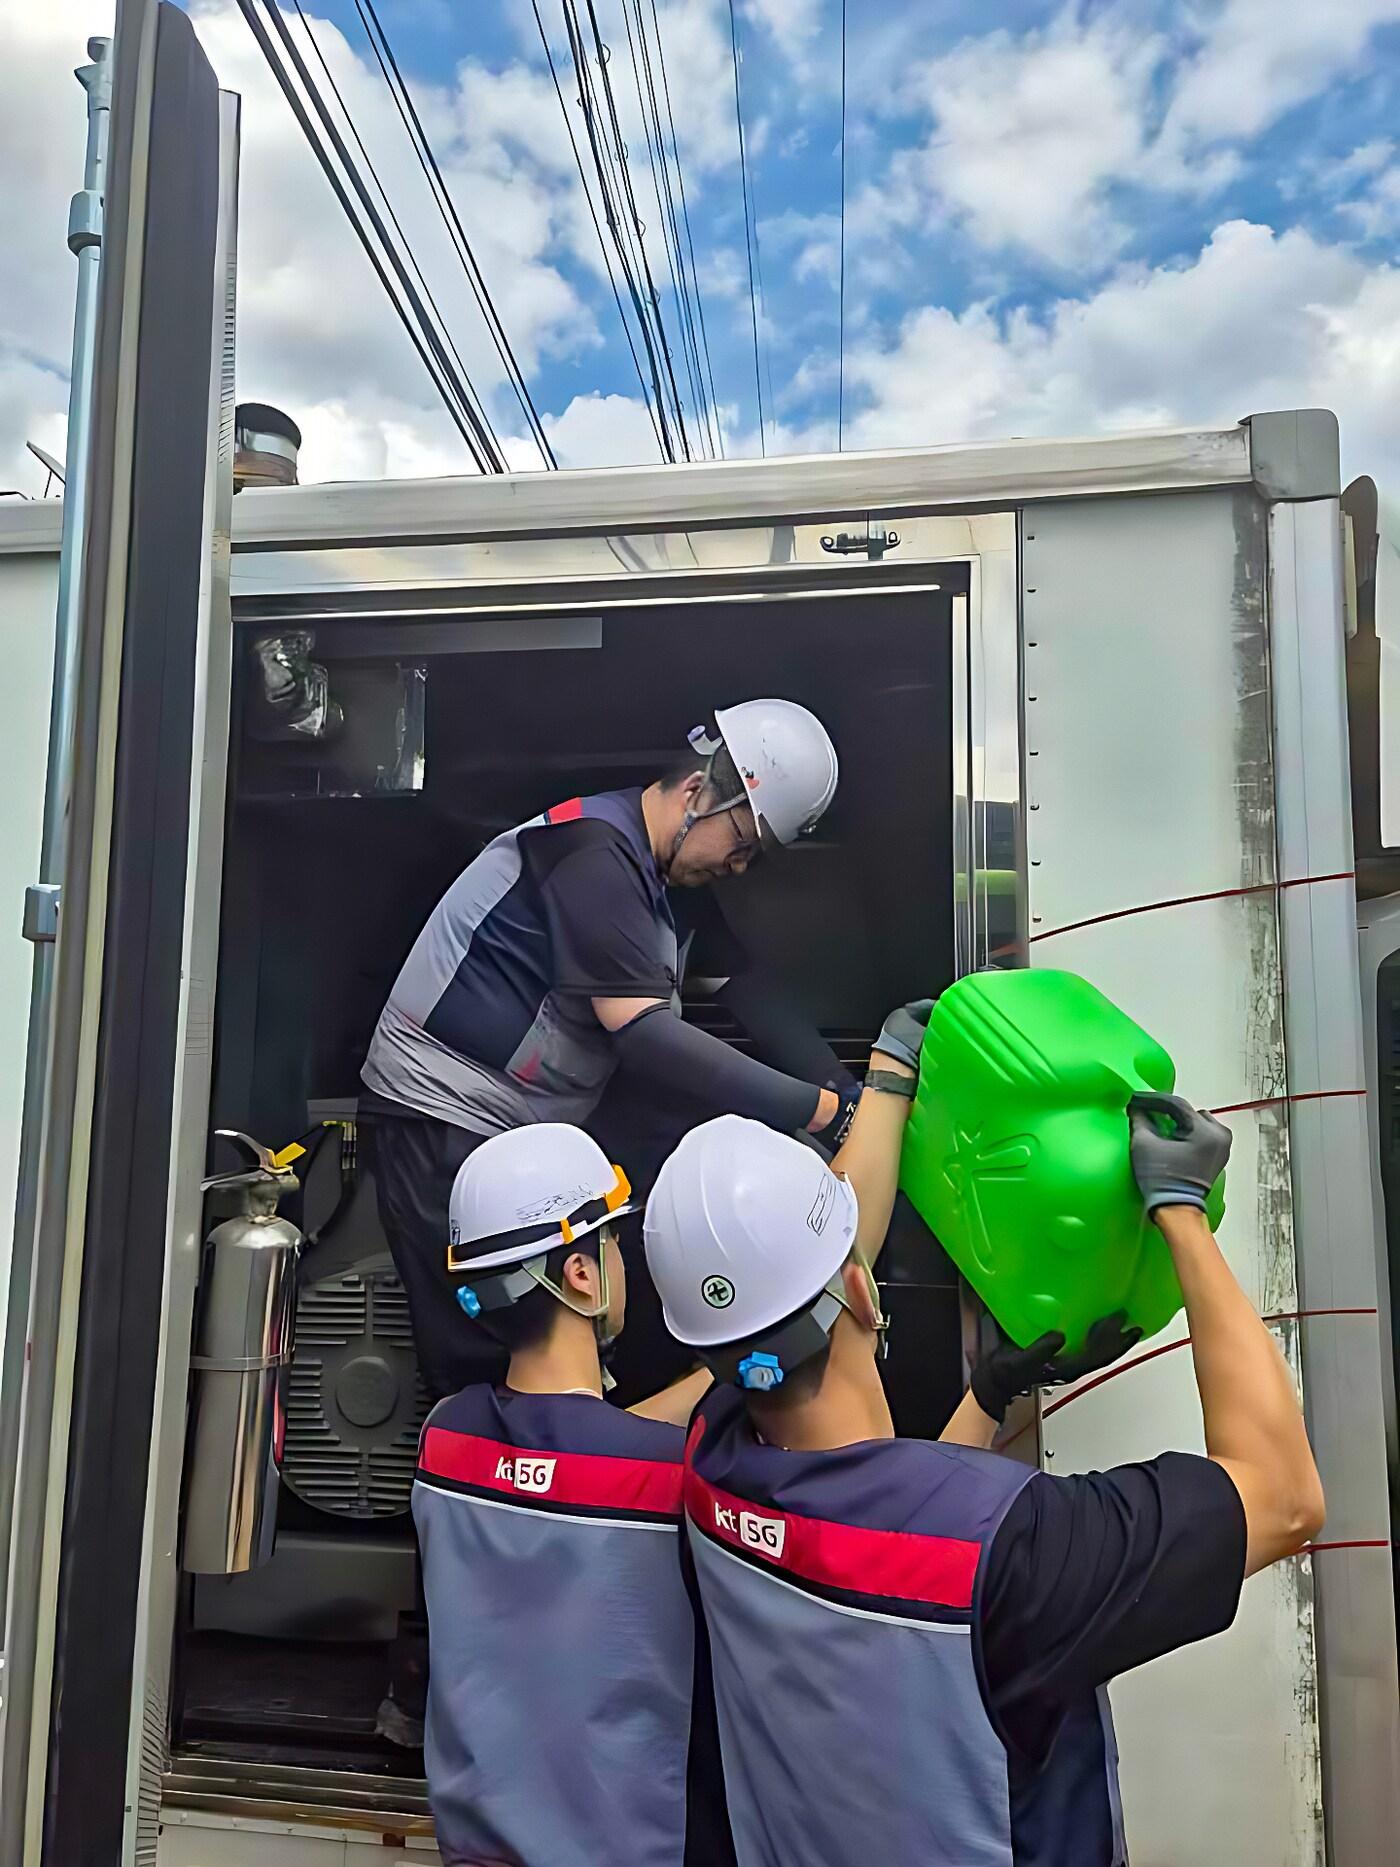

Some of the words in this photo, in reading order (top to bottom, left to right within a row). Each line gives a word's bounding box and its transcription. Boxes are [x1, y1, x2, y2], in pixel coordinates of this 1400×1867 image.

[518, 1462, 548, 1487] 5G
[715, 1502, 737, 1532] kt
[746, 1518, 779, 1549] 5G
